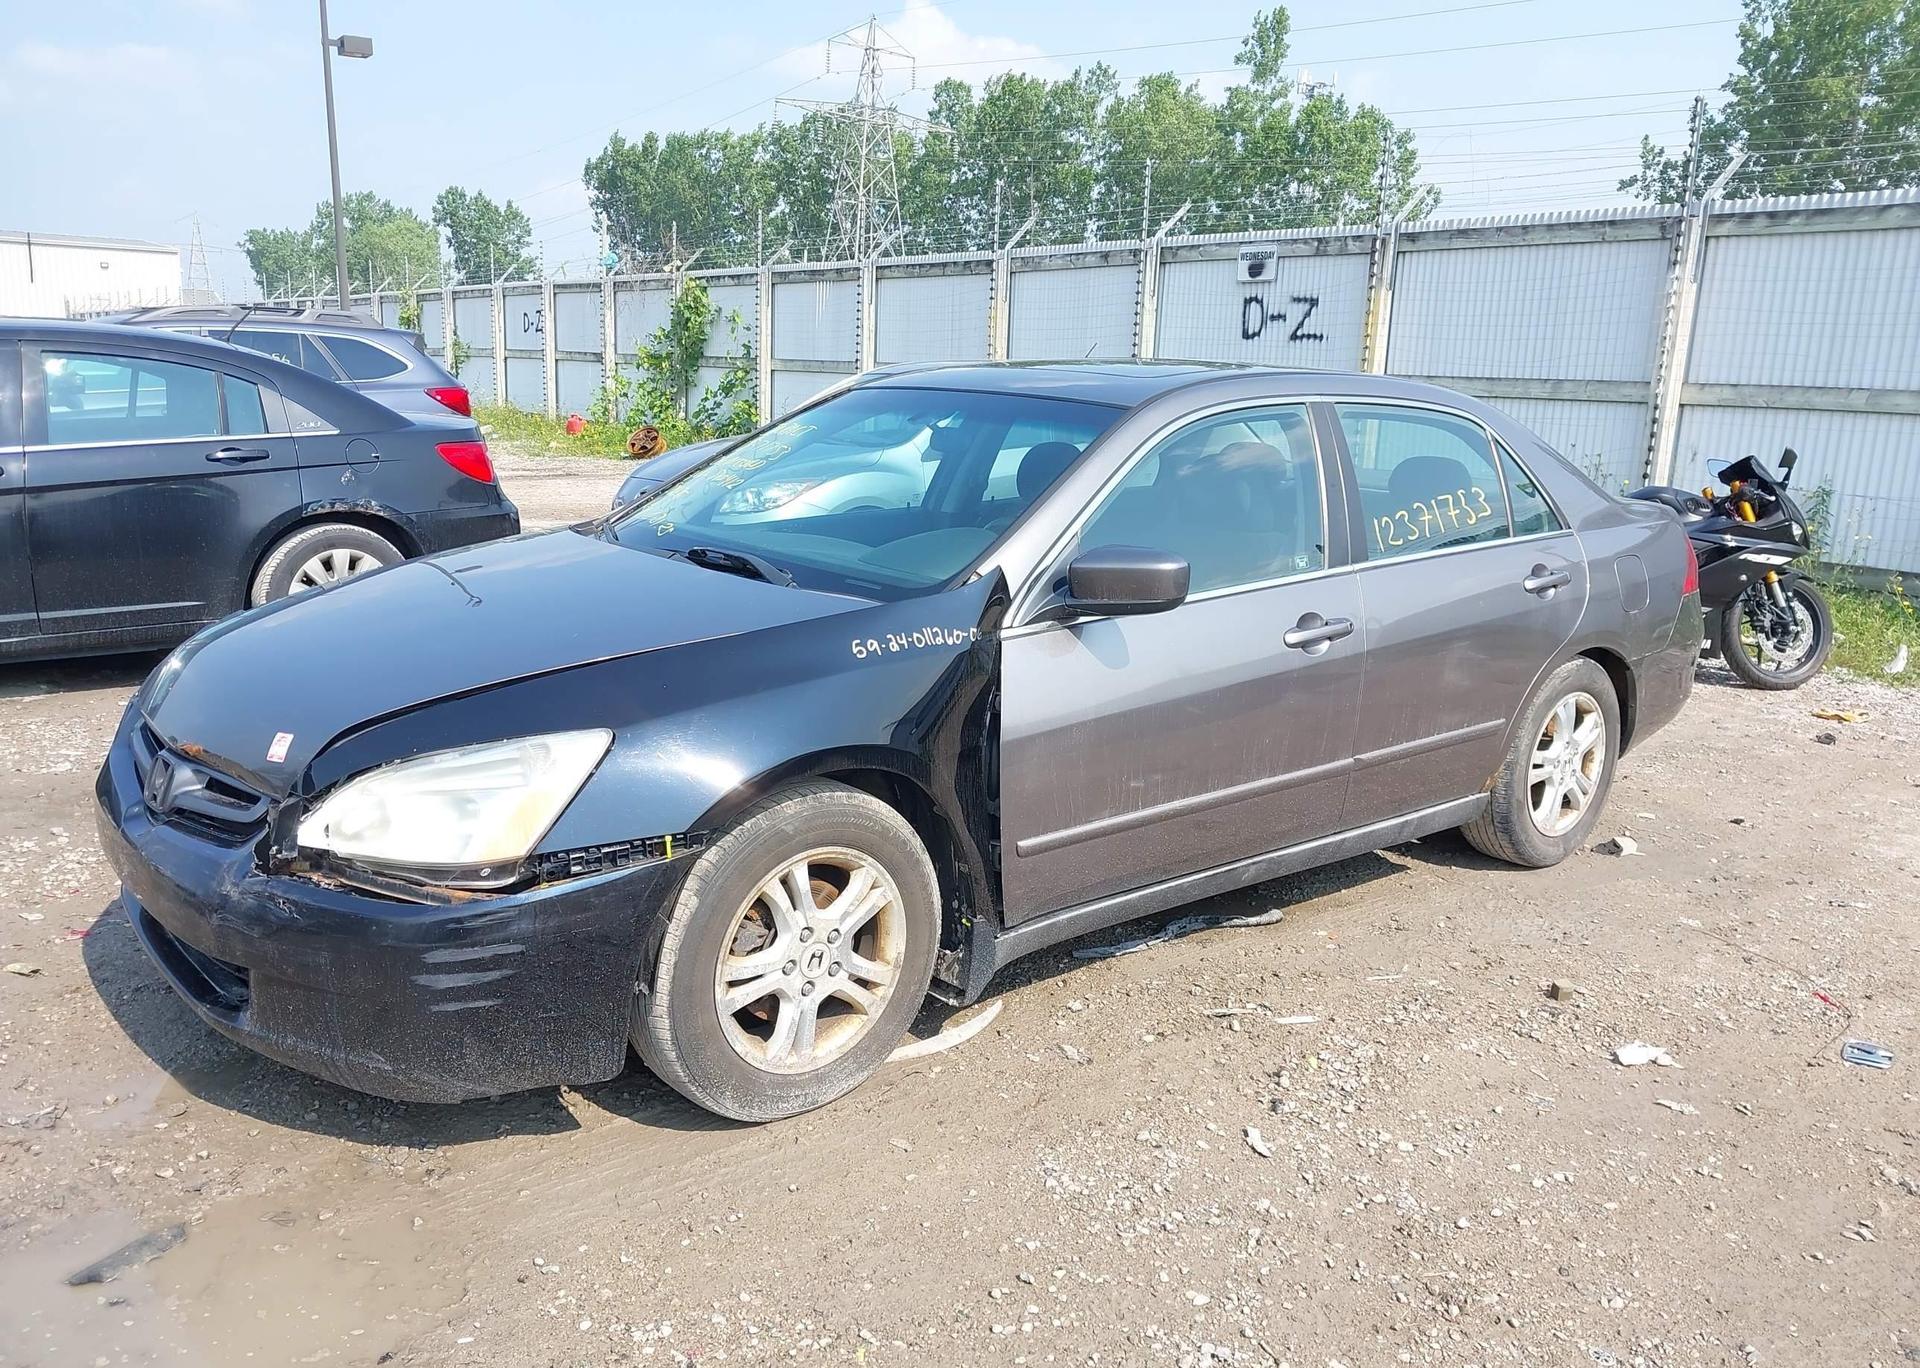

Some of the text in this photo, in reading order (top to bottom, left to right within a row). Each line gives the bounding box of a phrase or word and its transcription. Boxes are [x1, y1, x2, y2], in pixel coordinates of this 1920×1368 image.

[1240, 251, 1275, 261] WEDNESDAY
[1241, 295, 1324, 341] D-Z
[1373, 487, 1491, 552] 12371753
